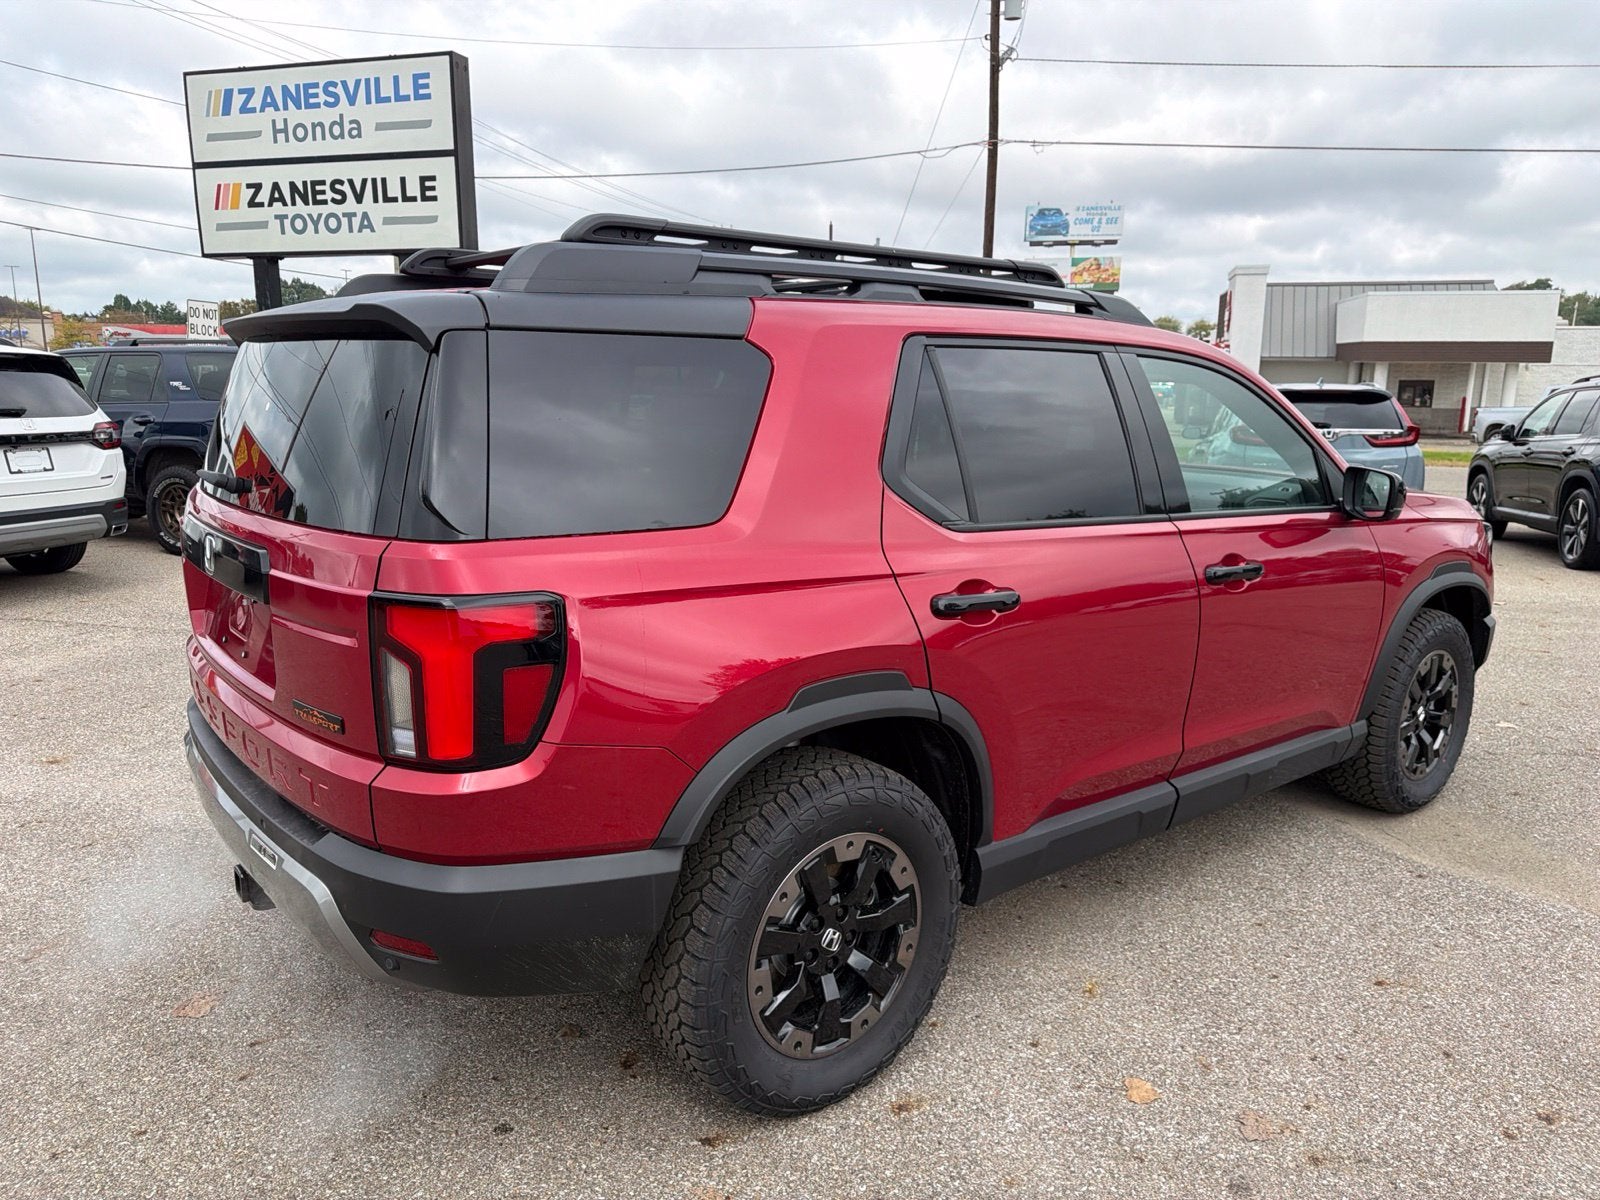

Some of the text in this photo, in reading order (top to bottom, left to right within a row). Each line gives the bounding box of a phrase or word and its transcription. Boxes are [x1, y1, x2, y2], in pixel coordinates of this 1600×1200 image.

[238, 72, 432, 115] ZANESVILLE
[271, 113, 363, 144] Honda
[245, 175, 438, 208] ZANESVILLE
[274, 211, 376, 235] TOYOTA
[1073, 217, 1095, 225] COME
[1105, 216, 1119, 225] SEE
[1091, 224, 1102, 232] US
[189, 306, 218, 321] DO NOT
[189, 323, 219, 337] BLOCK
